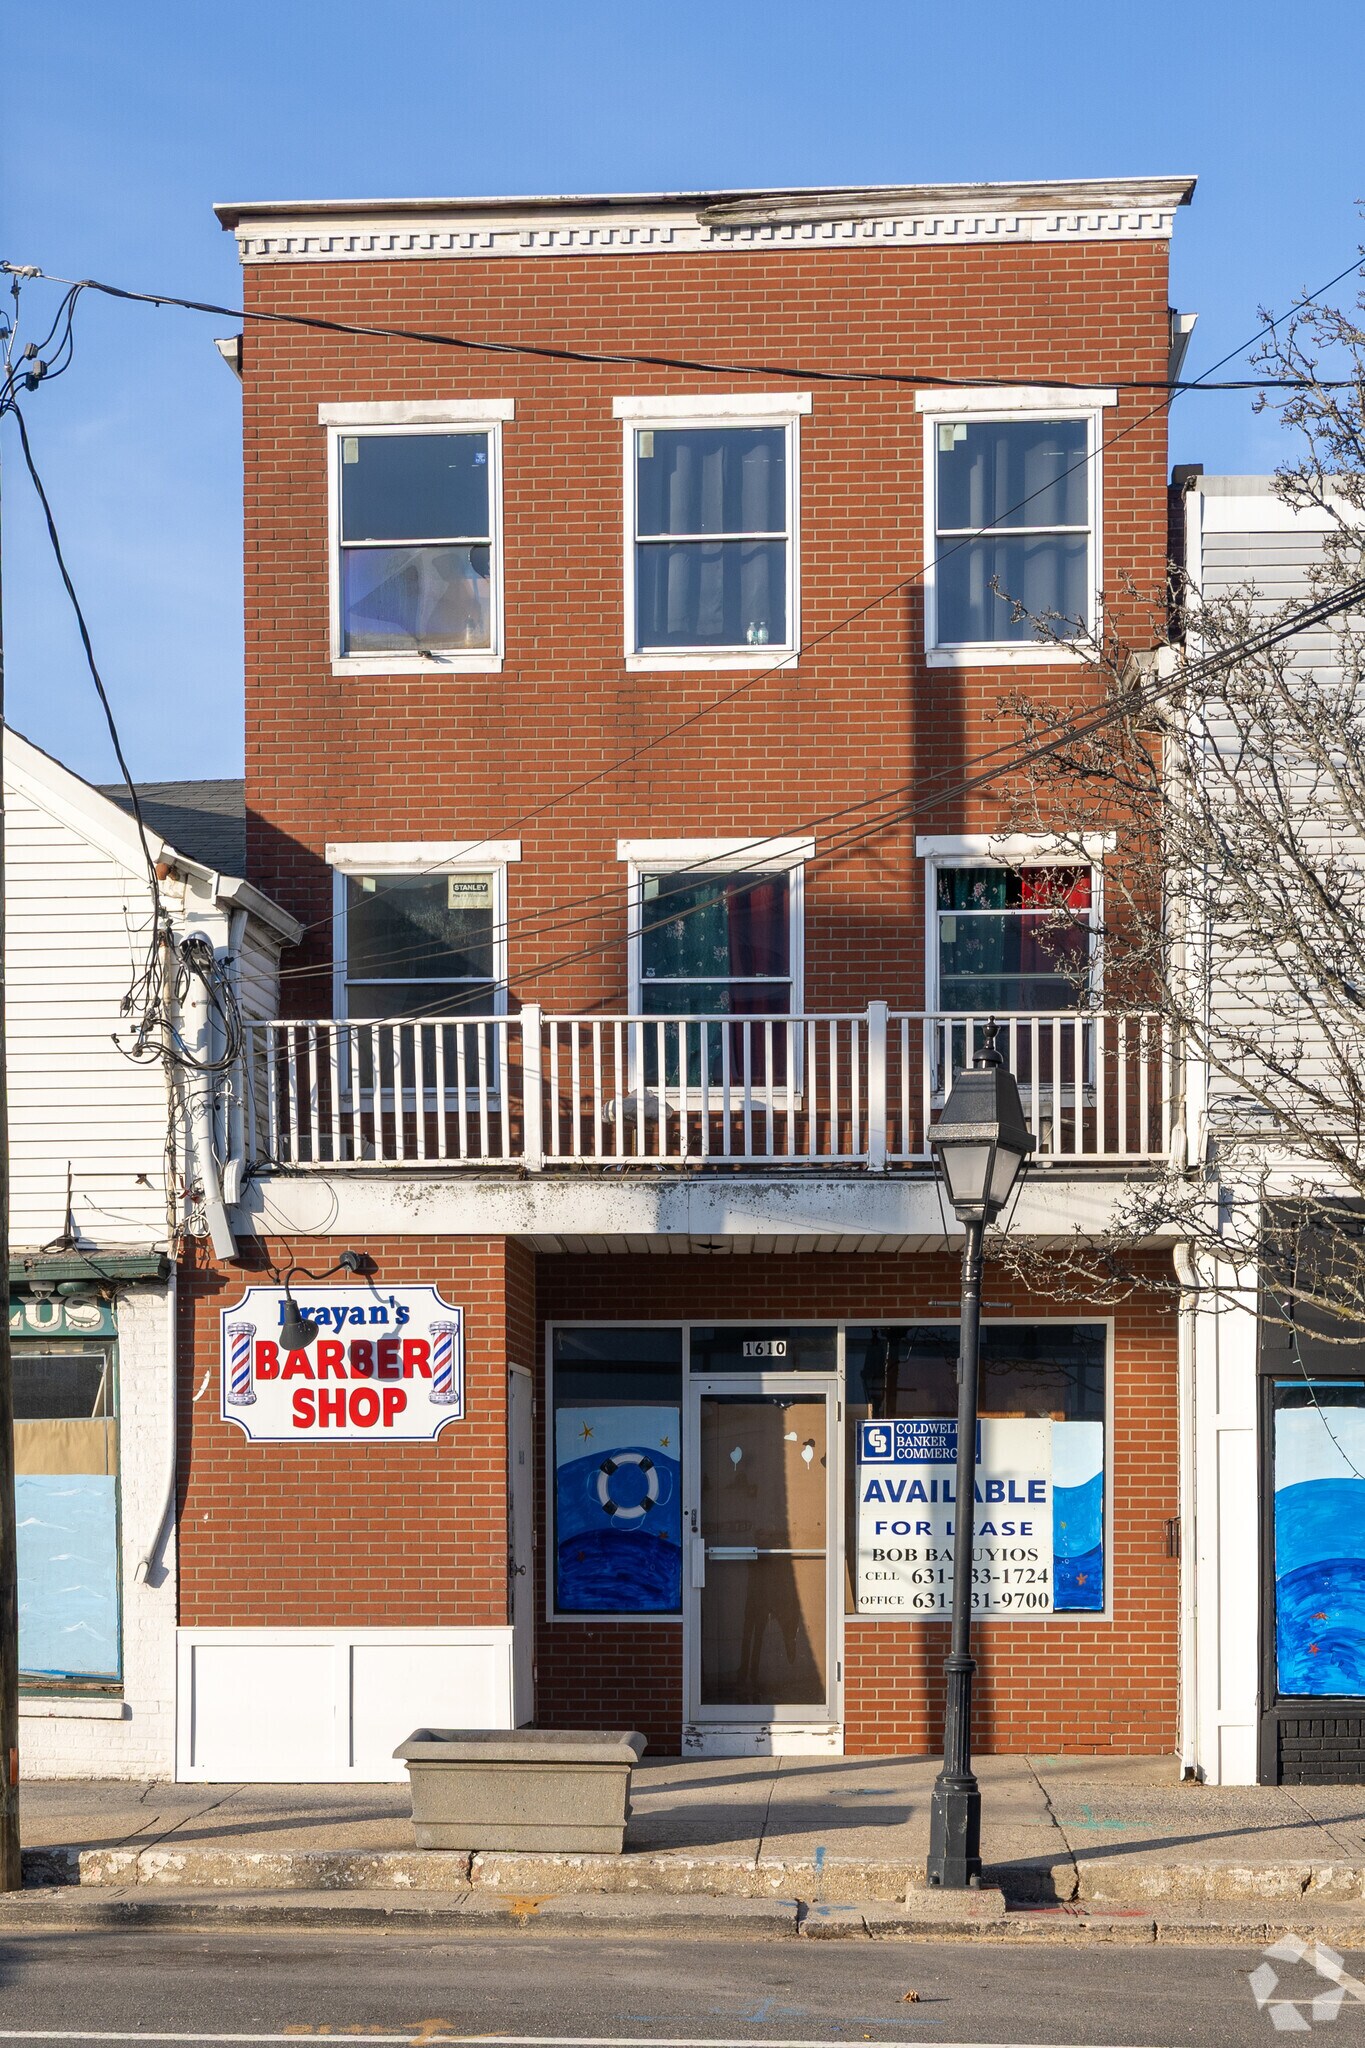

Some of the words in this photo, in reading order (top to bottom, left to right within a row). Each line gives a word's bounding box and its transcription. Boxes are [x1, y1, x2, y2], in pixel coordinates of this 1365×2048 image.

[745, 1341, 786, 1356] 1610
[255, 1339, 433, 1380] BARBER
[292, 1387, 407, 1429] SHOP
[896, 1436, 947, 1447] BANKER
[875, 1521, 932, 1536] FOR
[946, 1521, 1033, 1536] LASE
[872, 1548, 918, 1561] BOB
[925, 1547, 1039, 1562] BAUYIOS
[865, 1571, 900, 1581] CELL
[911, 1568, 1049, 1585] 631-33-1724
[860, 1595, 905, 1605] OFFICE
[912, 1592, 1050, 1609] 631-31-9700
